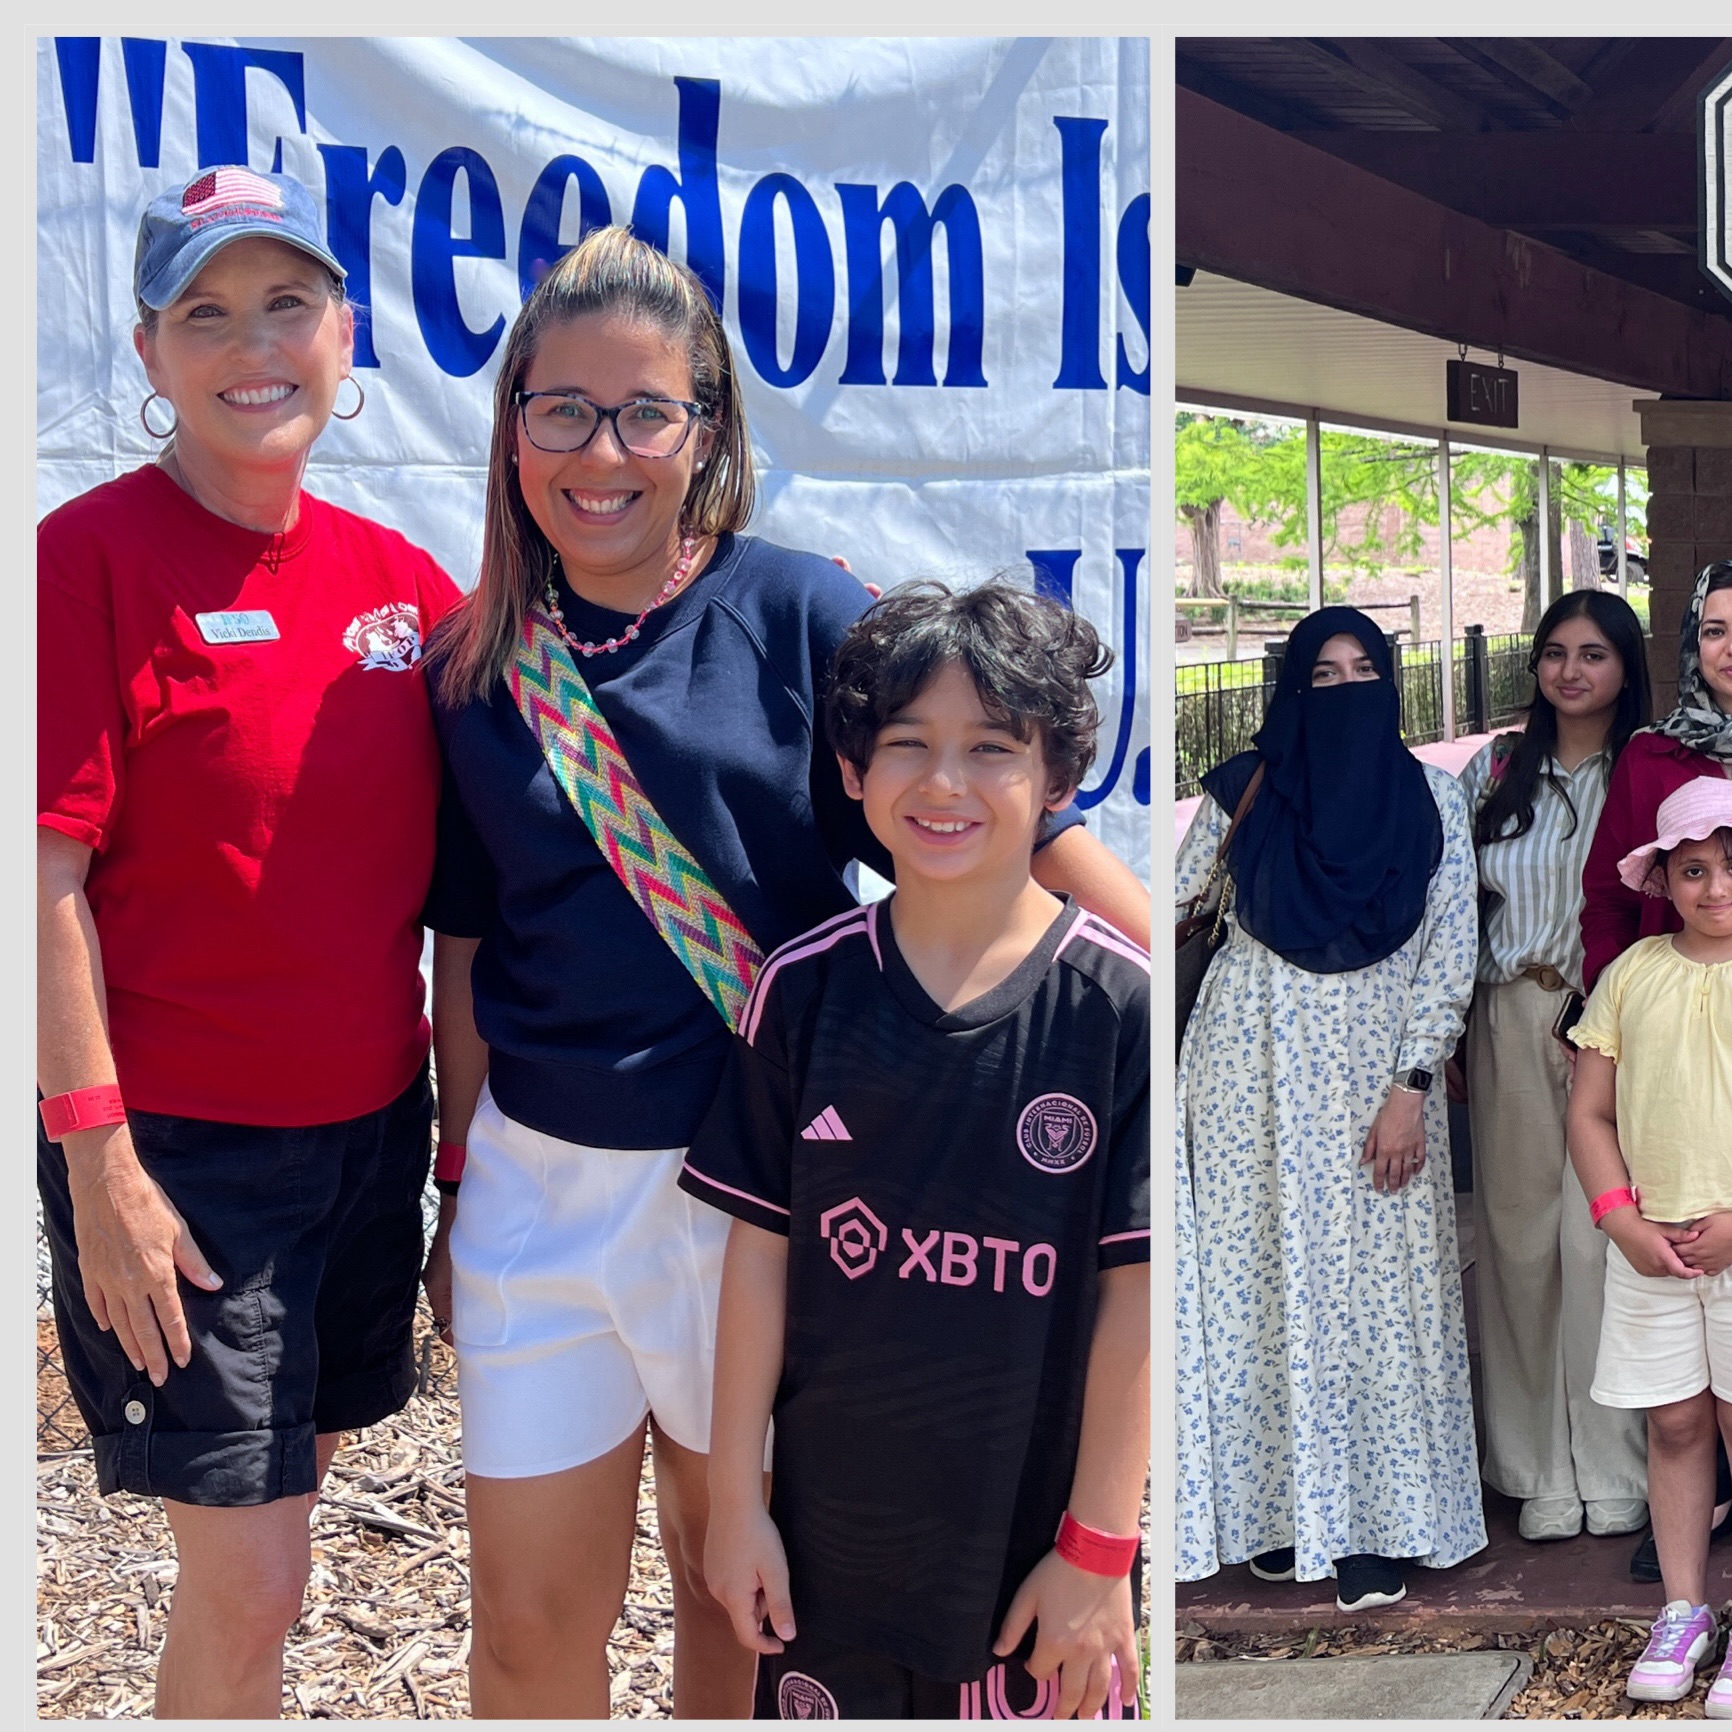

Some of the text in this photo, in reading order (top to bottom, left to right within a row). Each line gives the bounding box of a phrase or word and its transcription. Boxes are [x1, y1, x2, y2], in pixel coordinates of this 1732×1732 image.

[211, 625, 271, 639] Vicki Dendis
[1043, 1115, 1073, 1124] MIAMI
[899, 1228, 1057, 1297] XBTO
